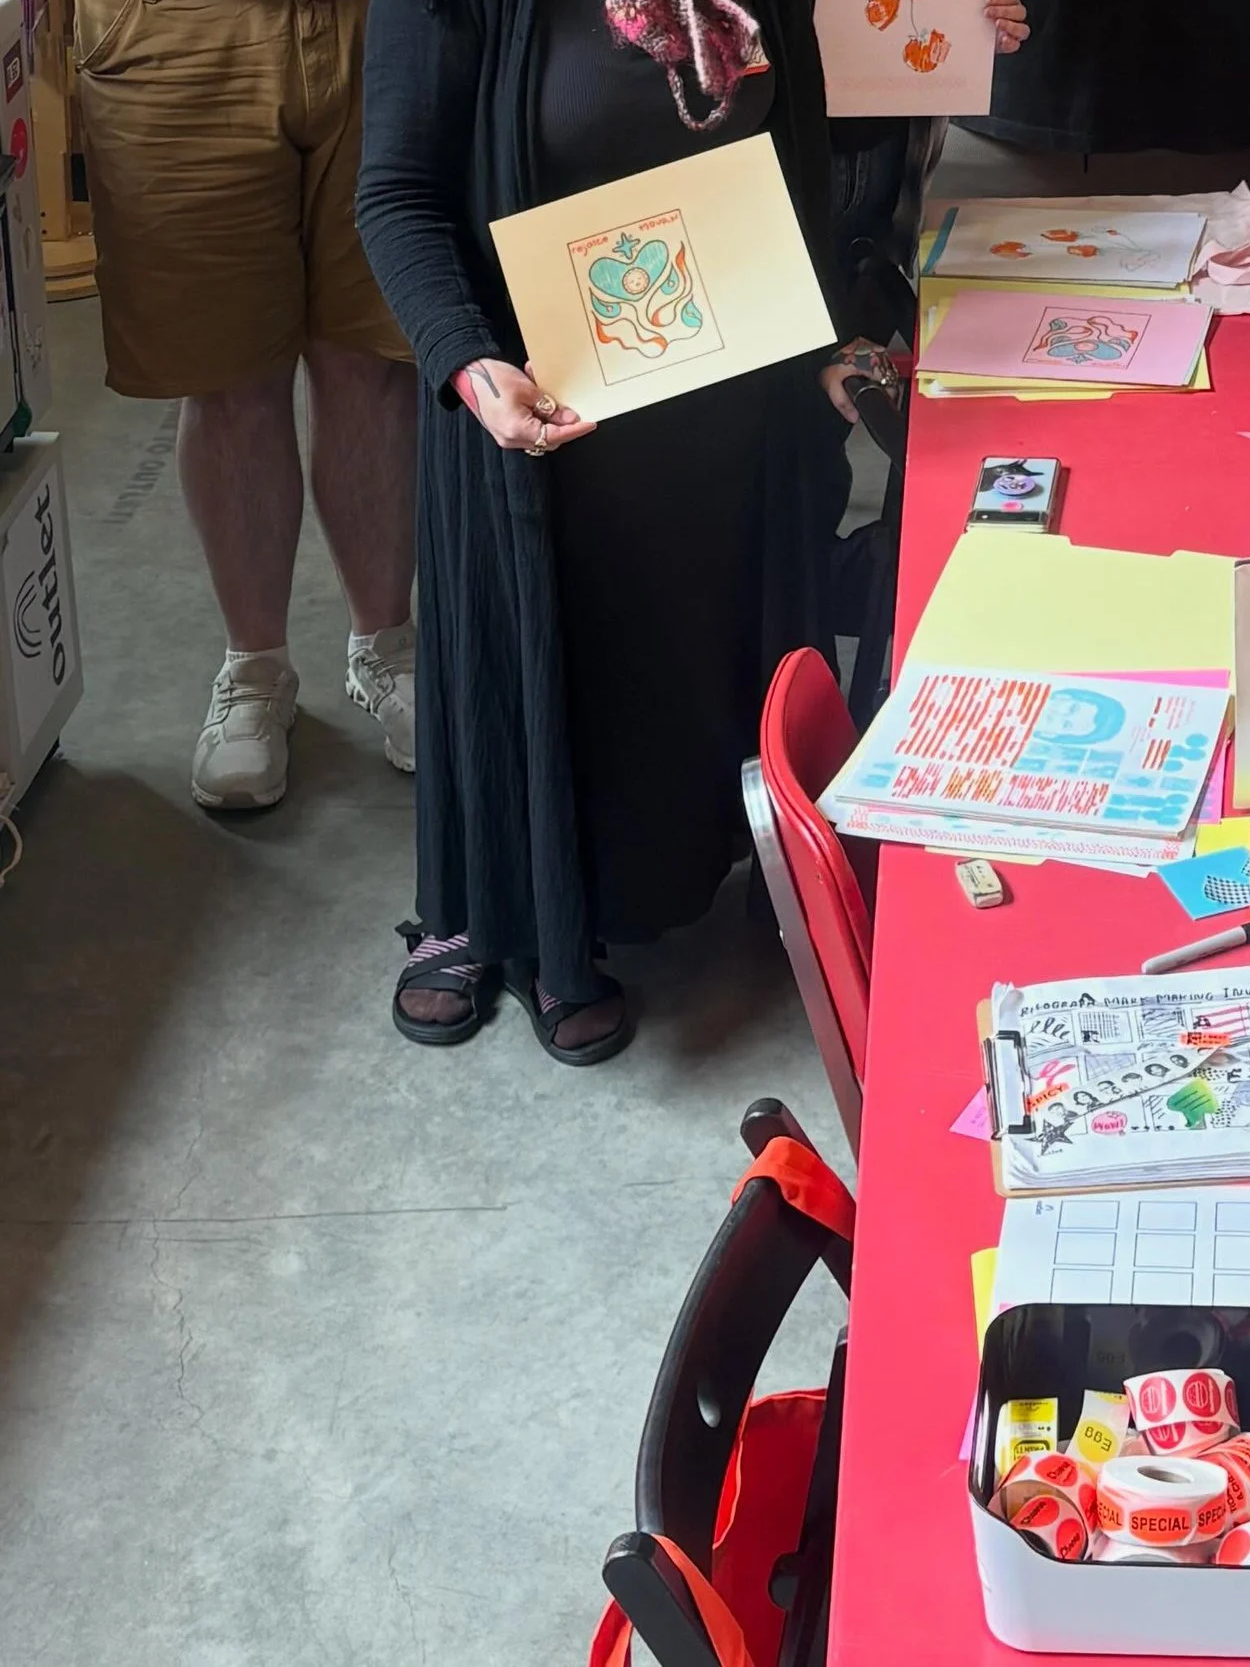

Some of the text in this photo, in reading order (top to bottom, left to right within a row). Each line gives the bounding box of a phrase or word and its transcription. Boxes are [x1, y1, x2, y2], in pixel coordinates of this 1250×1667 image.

[35, 483, 66, 686] outlet
[1156, 993, 1215, 1005] MAKING
[1084, 1425, 1113, 1453] Egg
[1131, 1516, 1190, 1533] SPECIAL
